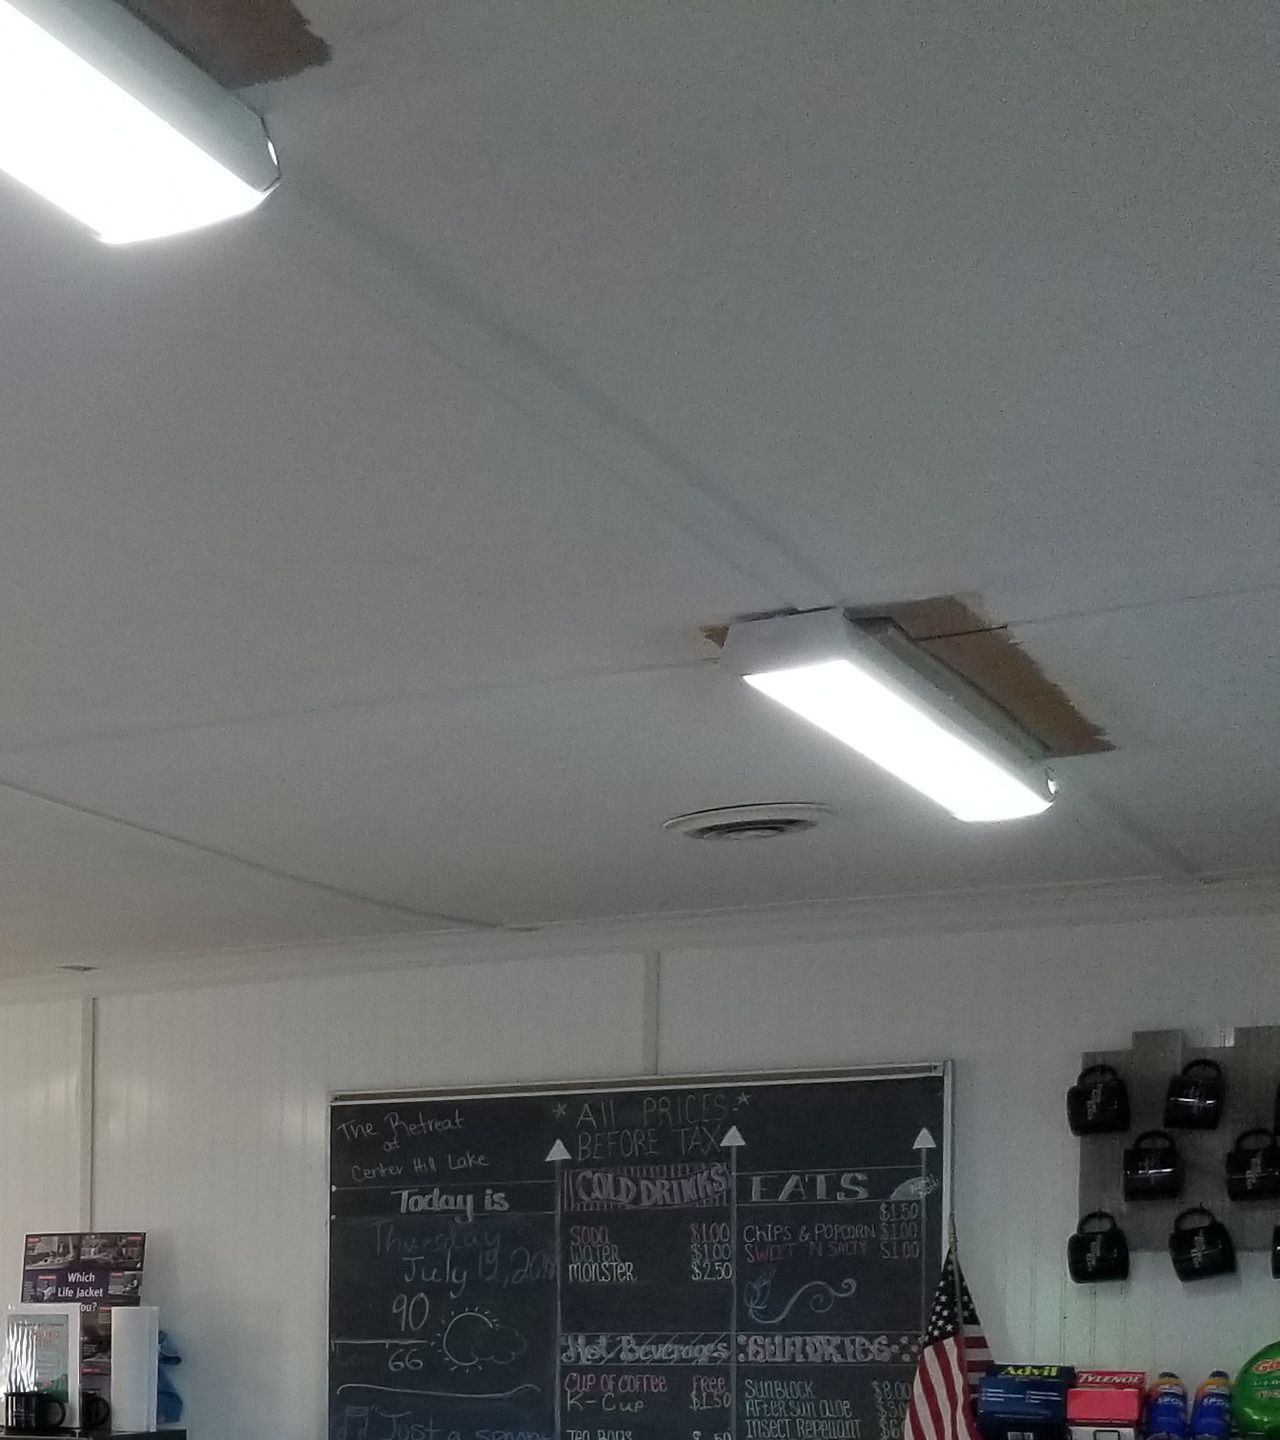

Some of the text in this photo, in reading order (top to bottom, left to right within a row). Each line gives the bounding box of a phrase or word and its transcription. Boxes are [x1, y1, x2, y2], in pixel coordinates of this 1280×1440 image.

[337, 1109, 465, 1142] The Retreat
[383, 1137, 401, 1152] at
[577, 1124, 721, 1161] BEFORE TAX
[351, 1150, 491, 1182] Center Hill Lake
[575, 1170, 637, 1204] COLD
[748, 1172, 870, 1201] EATS
[391, 1187, 511, 1223] Today is
[67, 1272, 96, 1283] Which
[401, 1248, 468, 1300] July
[57, 1287, 104, 1299] Life Jacket
[79, 1302, 98, 1312] ou?
[391, 1292, 430, 1333] 90
[387, 1349, 424, 1372] 66
[1001, 1365, 1058, 1377] Advil
